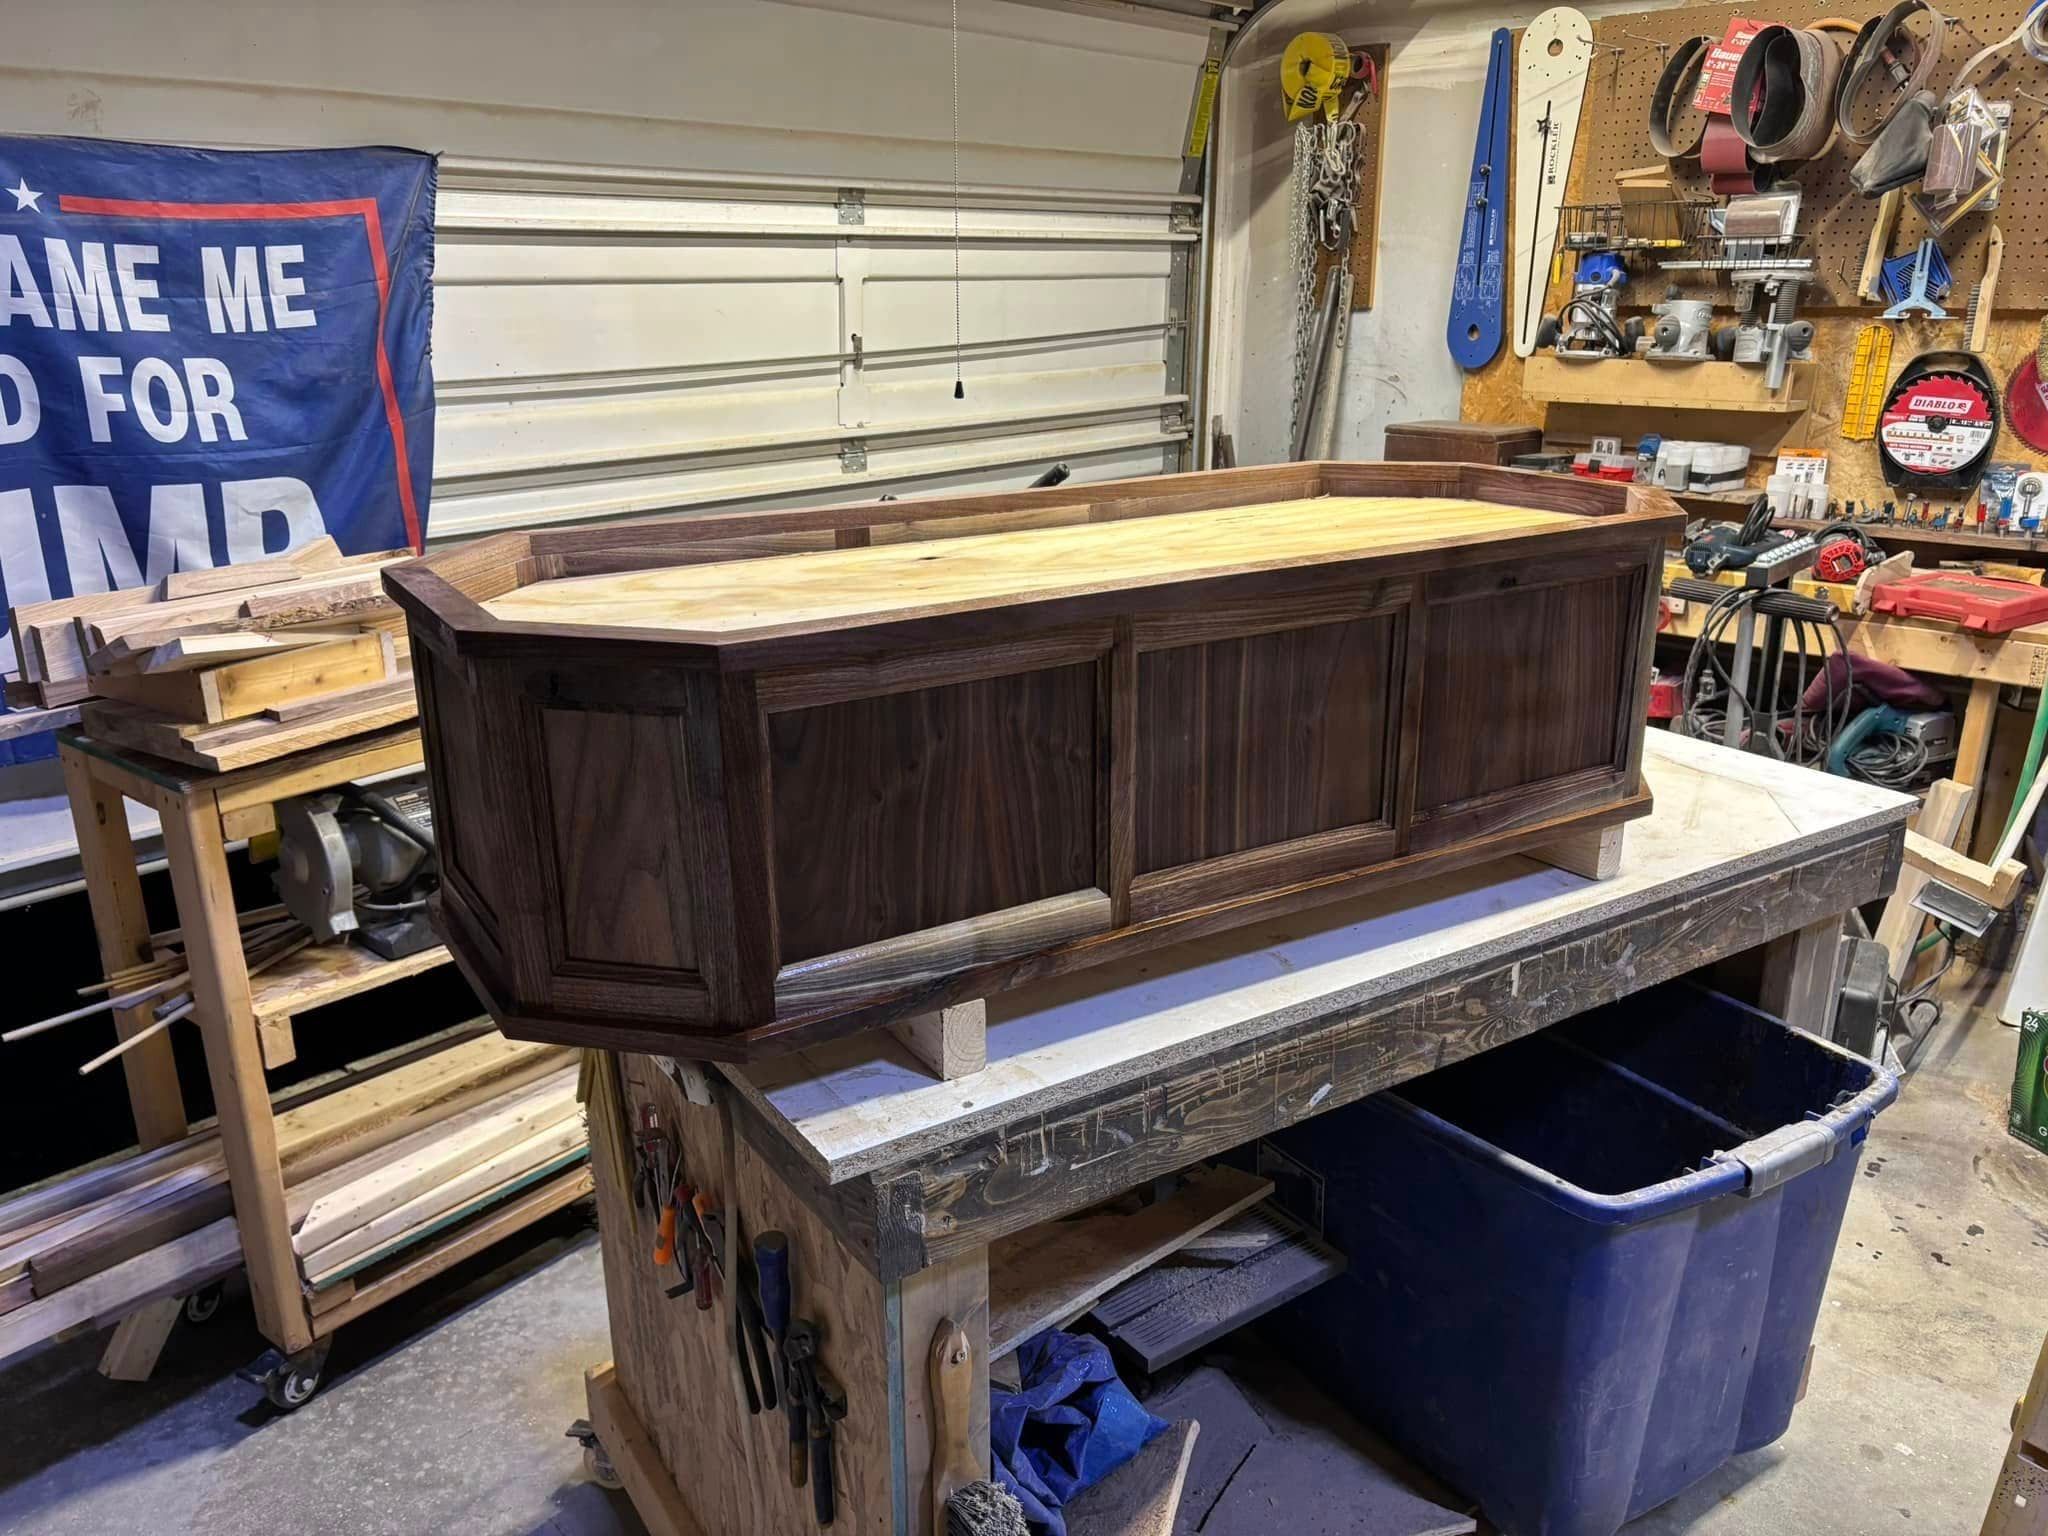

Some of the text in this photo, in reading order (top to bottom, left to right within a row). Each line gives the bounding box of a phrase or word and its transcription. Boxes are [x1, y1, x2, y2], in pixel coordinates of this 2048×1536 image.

[201, 244, 317, 334] ME
[77, 356, 249, 443] FOR
[1913, 398, 1956, 410] DIABLO
[2025, 1014, 2039, 1027] 24
